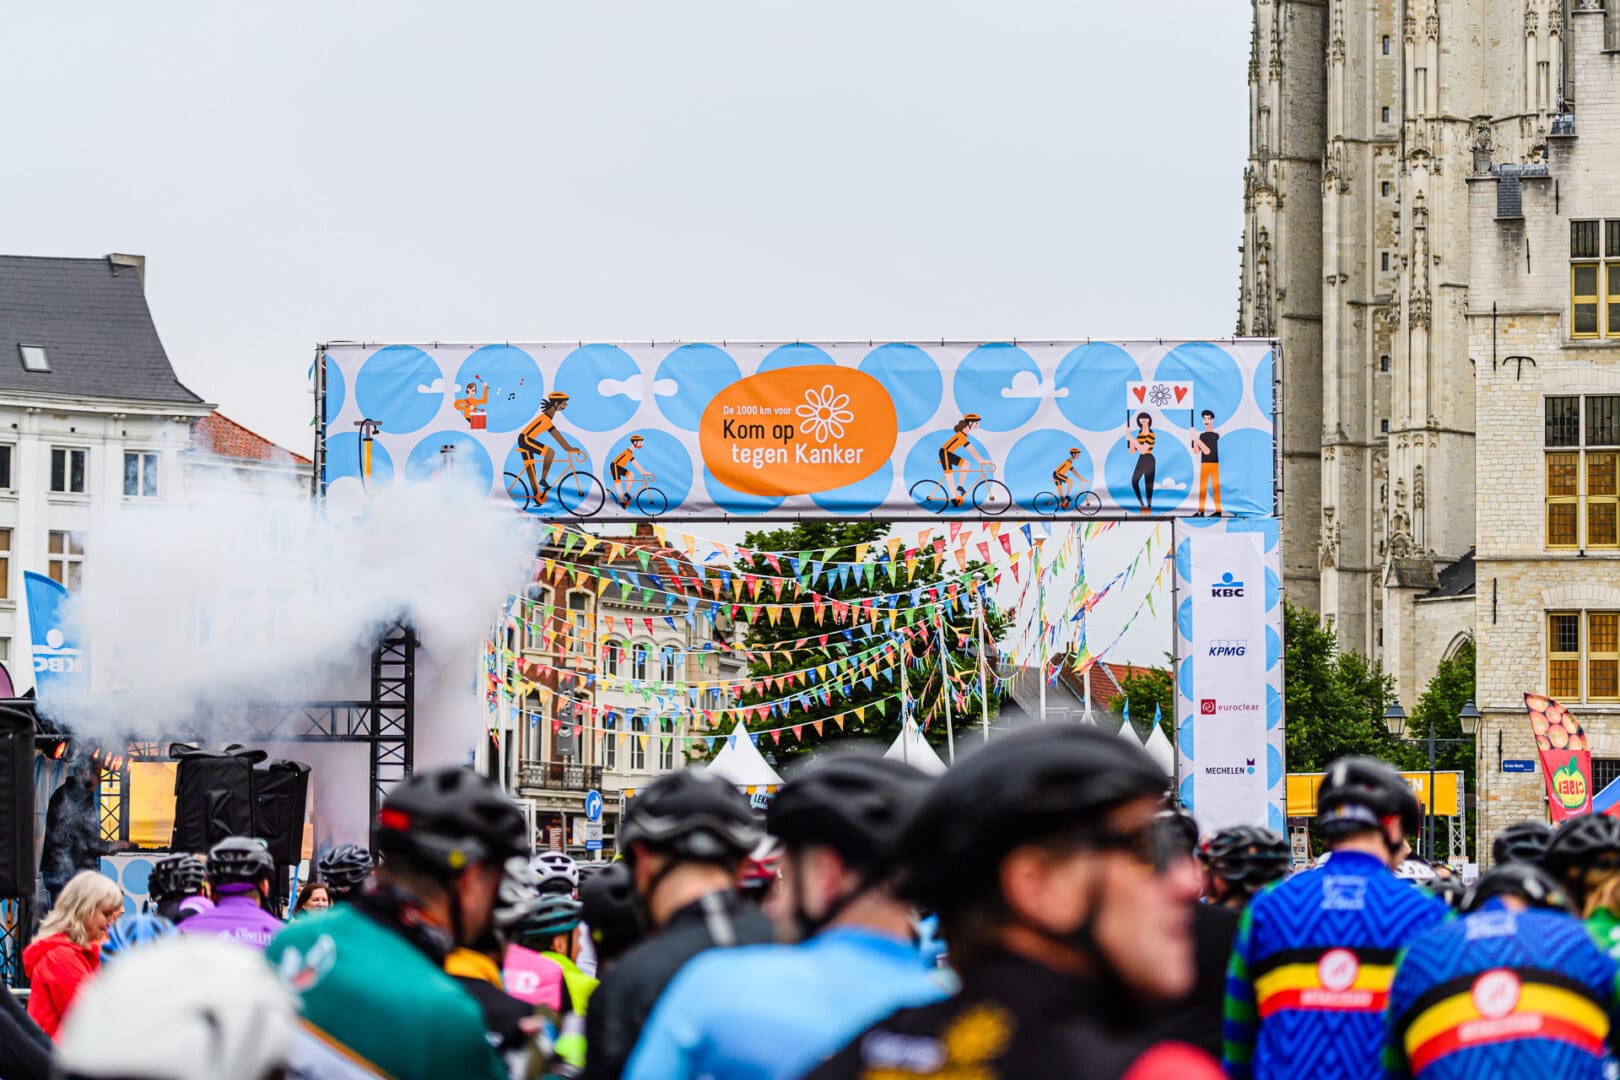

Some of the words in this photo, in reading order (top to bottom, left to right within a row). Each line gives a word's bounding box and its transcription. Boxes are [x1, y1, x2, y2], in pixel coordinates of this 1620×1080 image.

[723, 405, 734, 415] De
[736, 405, 758, 415] 1000
[759, 405, 772, 415] km
[774, 407, 792, 415] voor
[723, 419, 765, 439] Kom
[772, 423, 794, 445] op
[731, 443, 788, 469] tegen
[795, 443, 864, 464] Kanker
[1211, 588, 1245, 598] KBC
[1208, 646, 1246, 657] KPMG
[1218, 703, 1260, 711] euroclear
[1205, 767, 1245, 775] MECHELEN
